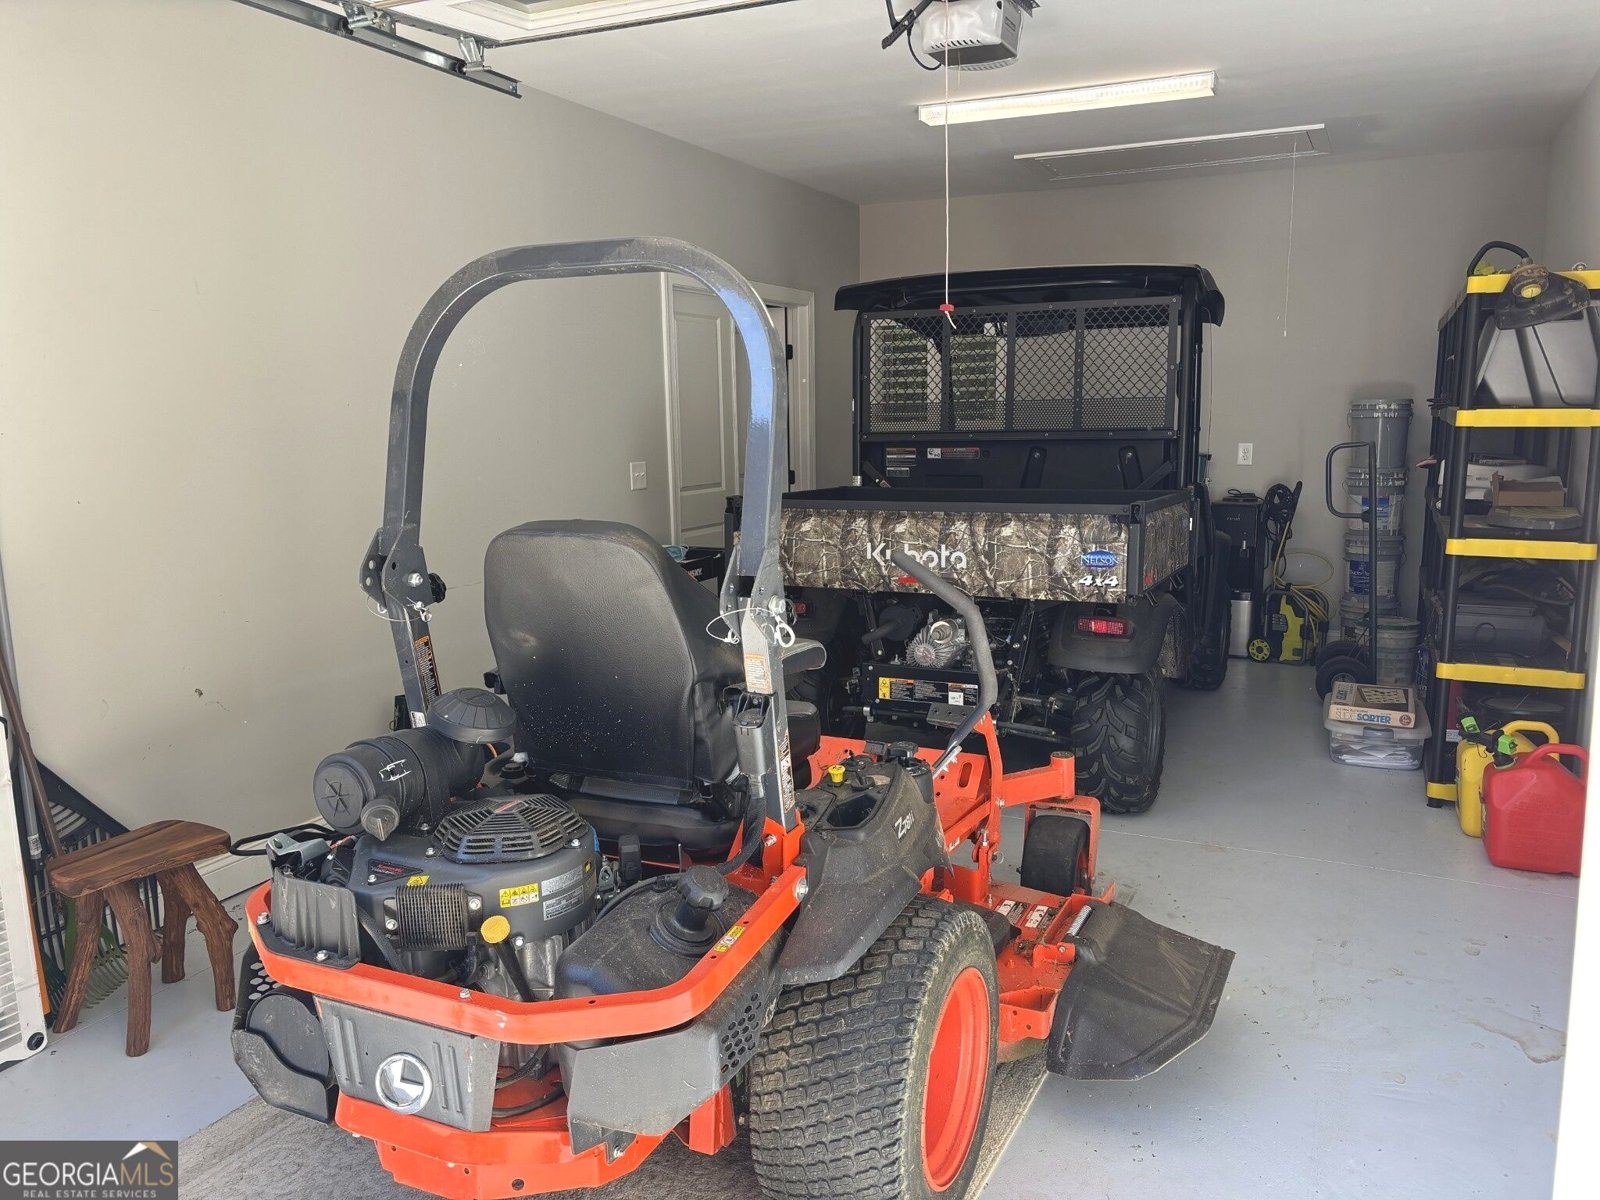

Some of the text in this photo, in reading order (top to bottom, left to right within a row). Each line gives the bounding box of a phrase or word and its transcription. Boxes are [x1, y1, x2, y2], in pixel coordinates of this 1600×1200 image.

[1080, 553, 1119, 566] NELSON
[1078, 575, 1119, 588] 4x4
[1356, 712, 1392, 724] SORTER
